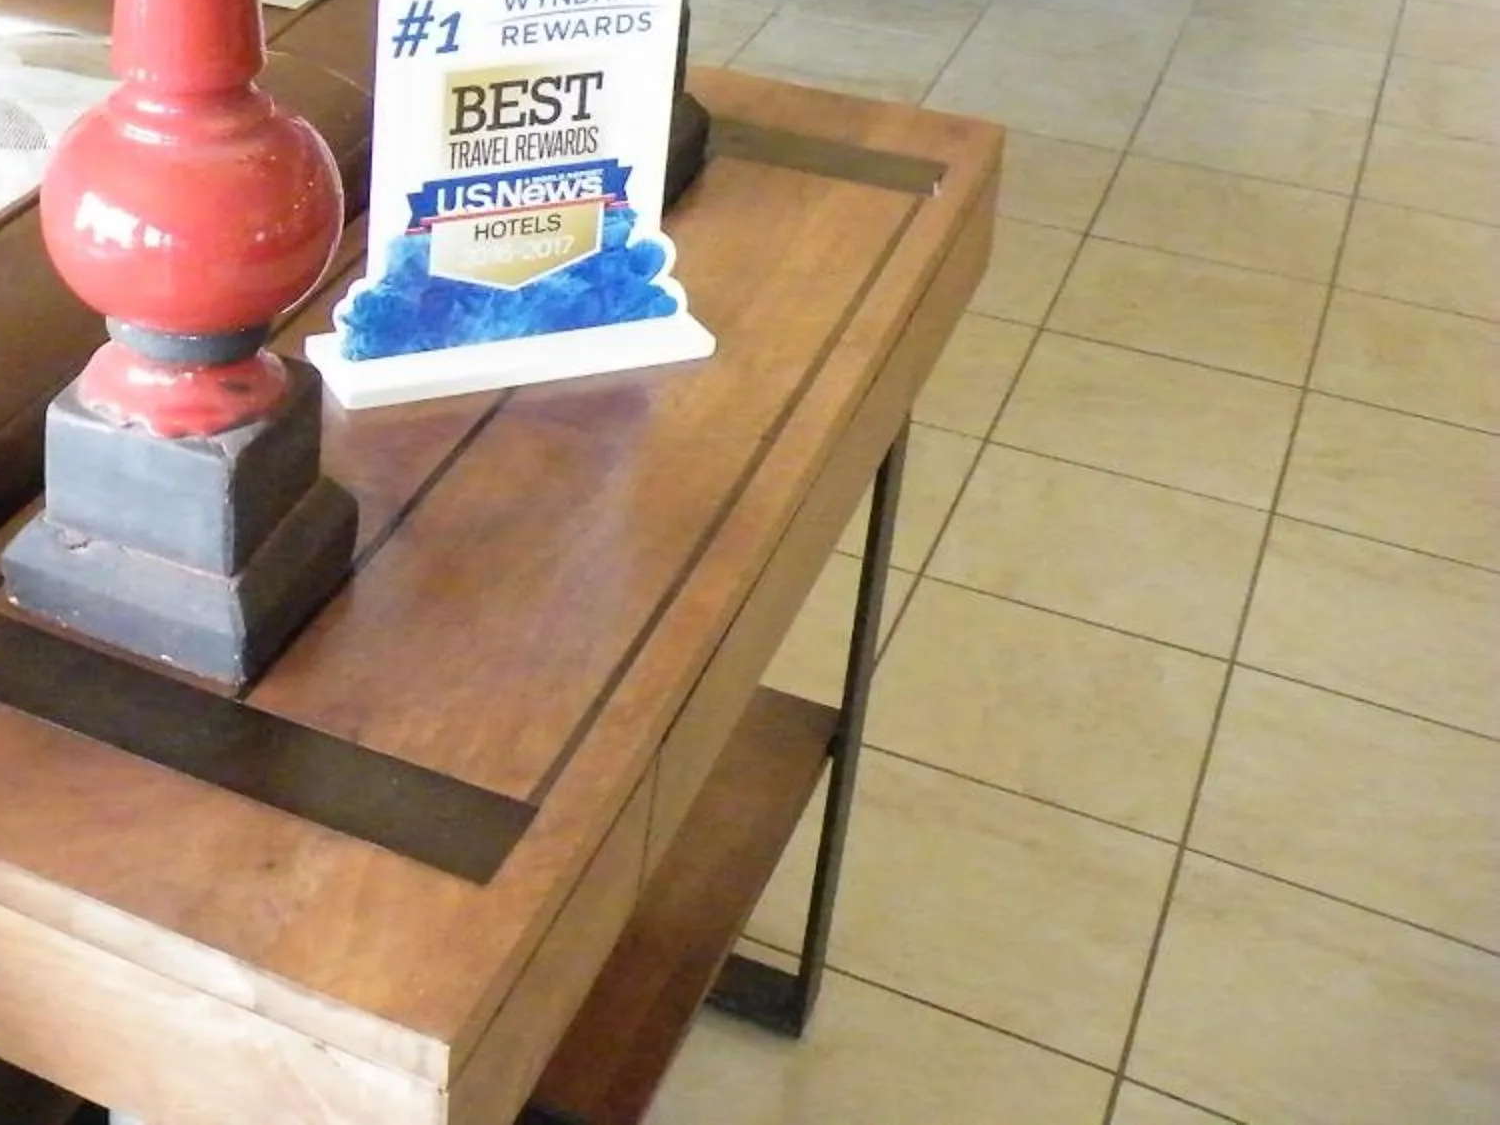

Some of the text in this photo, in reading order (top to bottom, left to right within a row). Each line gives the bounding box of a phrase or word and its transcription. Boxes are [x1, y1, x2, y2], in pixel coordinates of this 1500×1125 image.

[391, 0, 462, 58] #1
[501, 11, 653, 46] REWARDS
[449, 71, 603, 136] BEST
[449, 126, 599, 170] TRAVEL REWARDS
[474, 214, 562, 241] HOTELS
